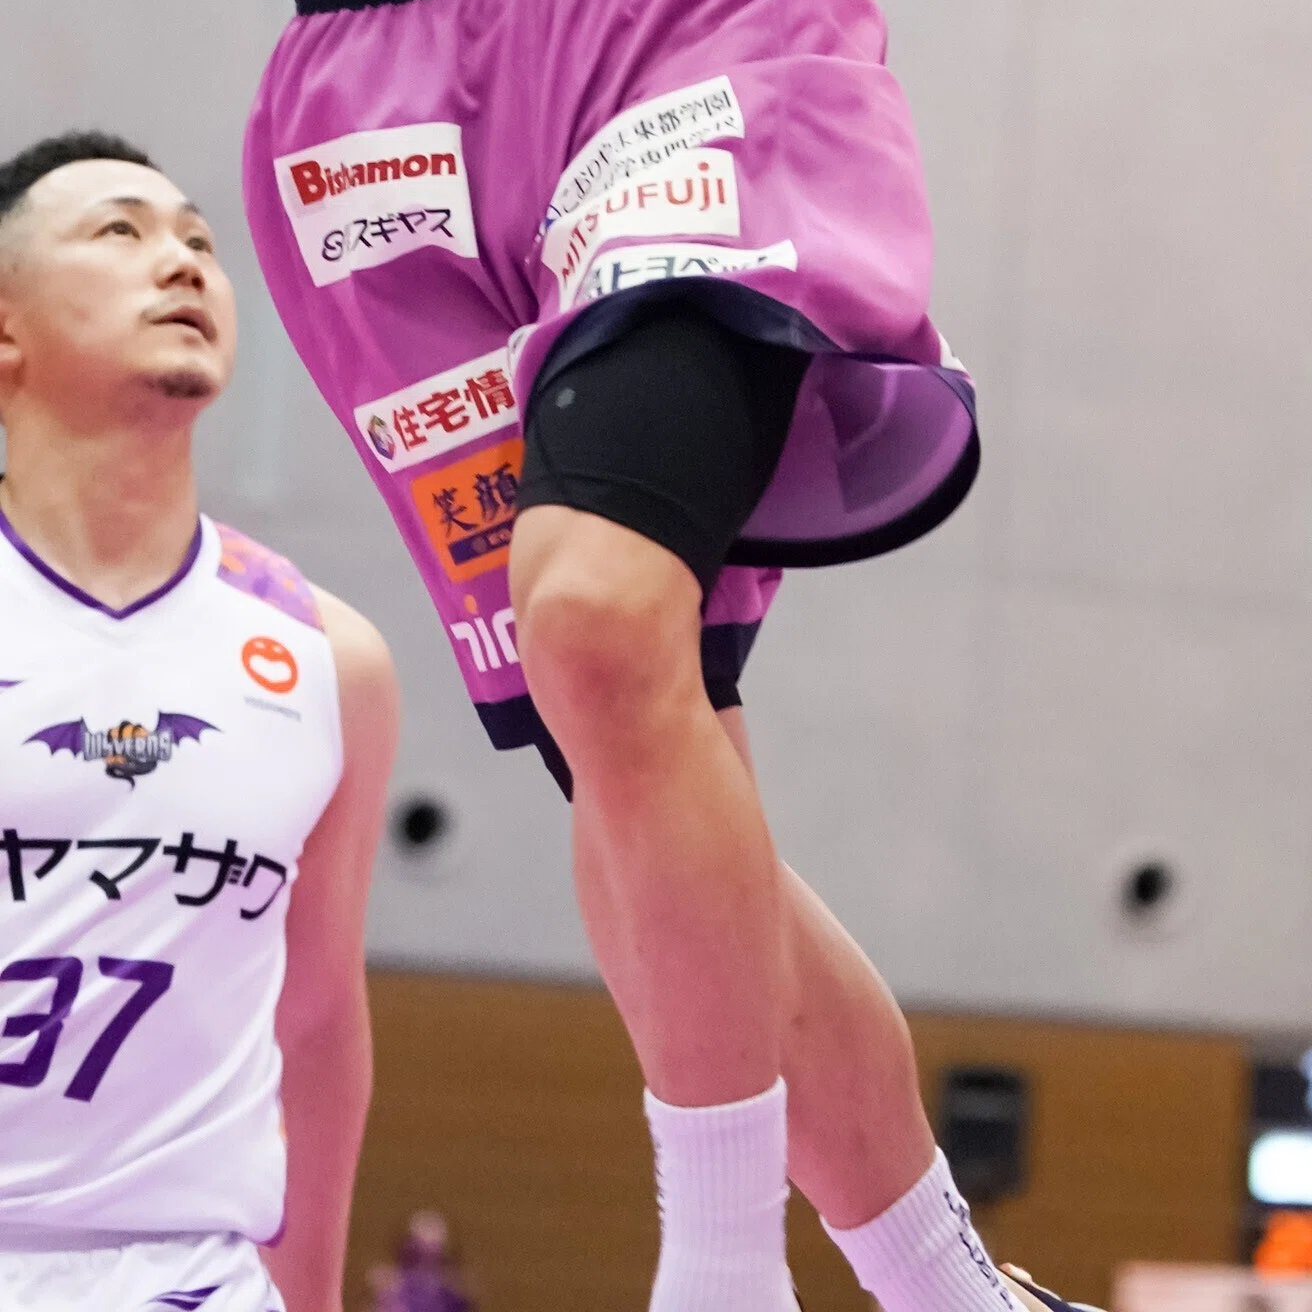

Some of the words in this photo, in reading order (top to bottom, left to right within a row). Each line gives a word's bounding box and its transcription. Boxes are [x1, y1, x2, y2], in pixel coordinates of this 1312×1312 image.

[0, 829, 287, 921] ヤマザワ
[0, 956, 175, 1102] 37
